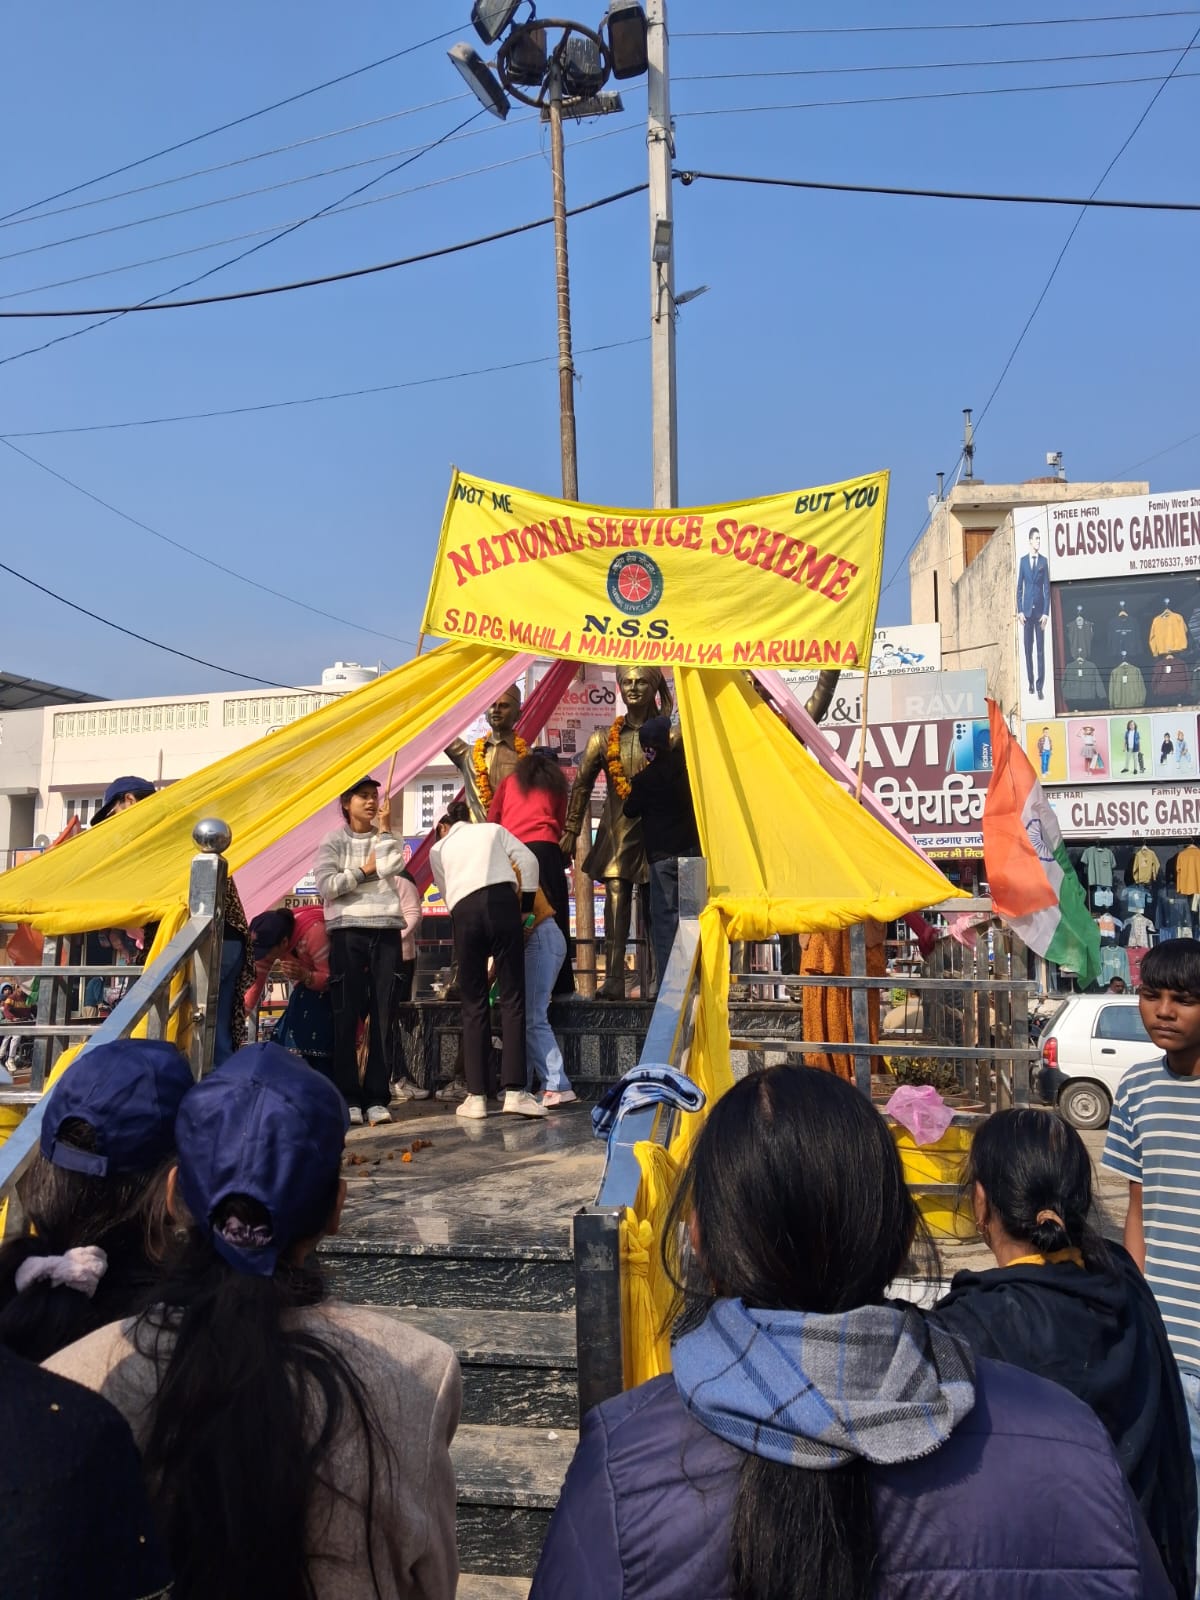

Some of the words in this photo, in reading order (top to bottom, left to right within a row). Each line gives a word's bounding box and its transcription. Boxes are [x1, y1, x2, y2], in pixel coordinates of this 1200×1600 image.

[454, 483, 485, 507] NOT
[492, 491, 513, 513] ME
[794, 491, 836, 514] BUT
[842, 486, 880, 511] YOU
[1148, 499, 1170, 512] Family
[1171, 498, 1189, 509] Wear
[1053, 508, 1079, 520] SHREE
[1080, 506, 1100, 519] HARI
[1054, 517, 1125, 557] CLASSIC
[1129, 511, 1200, 551] GARMEN
[446, 516, 585, 587] NATIONAL
[586, 515, 704, 550] SERVICE
[711, 518, 860, 603] SCHEME
[1130, 560, 1138, 570] M.
[582, 614, 675, 641] N.S.S.
[509, 619, 572, 653] MAHILA
[577, 633, 723, 664] MAHAVIDYALYA
[733, 639, 860, 666] NARWANA
[905, 692, 974, 717] RAVI
[1046, 792, 1062, 800] REE
[1063, 791, 1083, 799] HARI
[1151, 787, 1182, 797] Family
[1183, 786, 1200, 795] We
[1071, 801, 1149, 827] CLASSIC
[963, 847, 984, 858] मिल
[284, 898, 300, 909] RD
